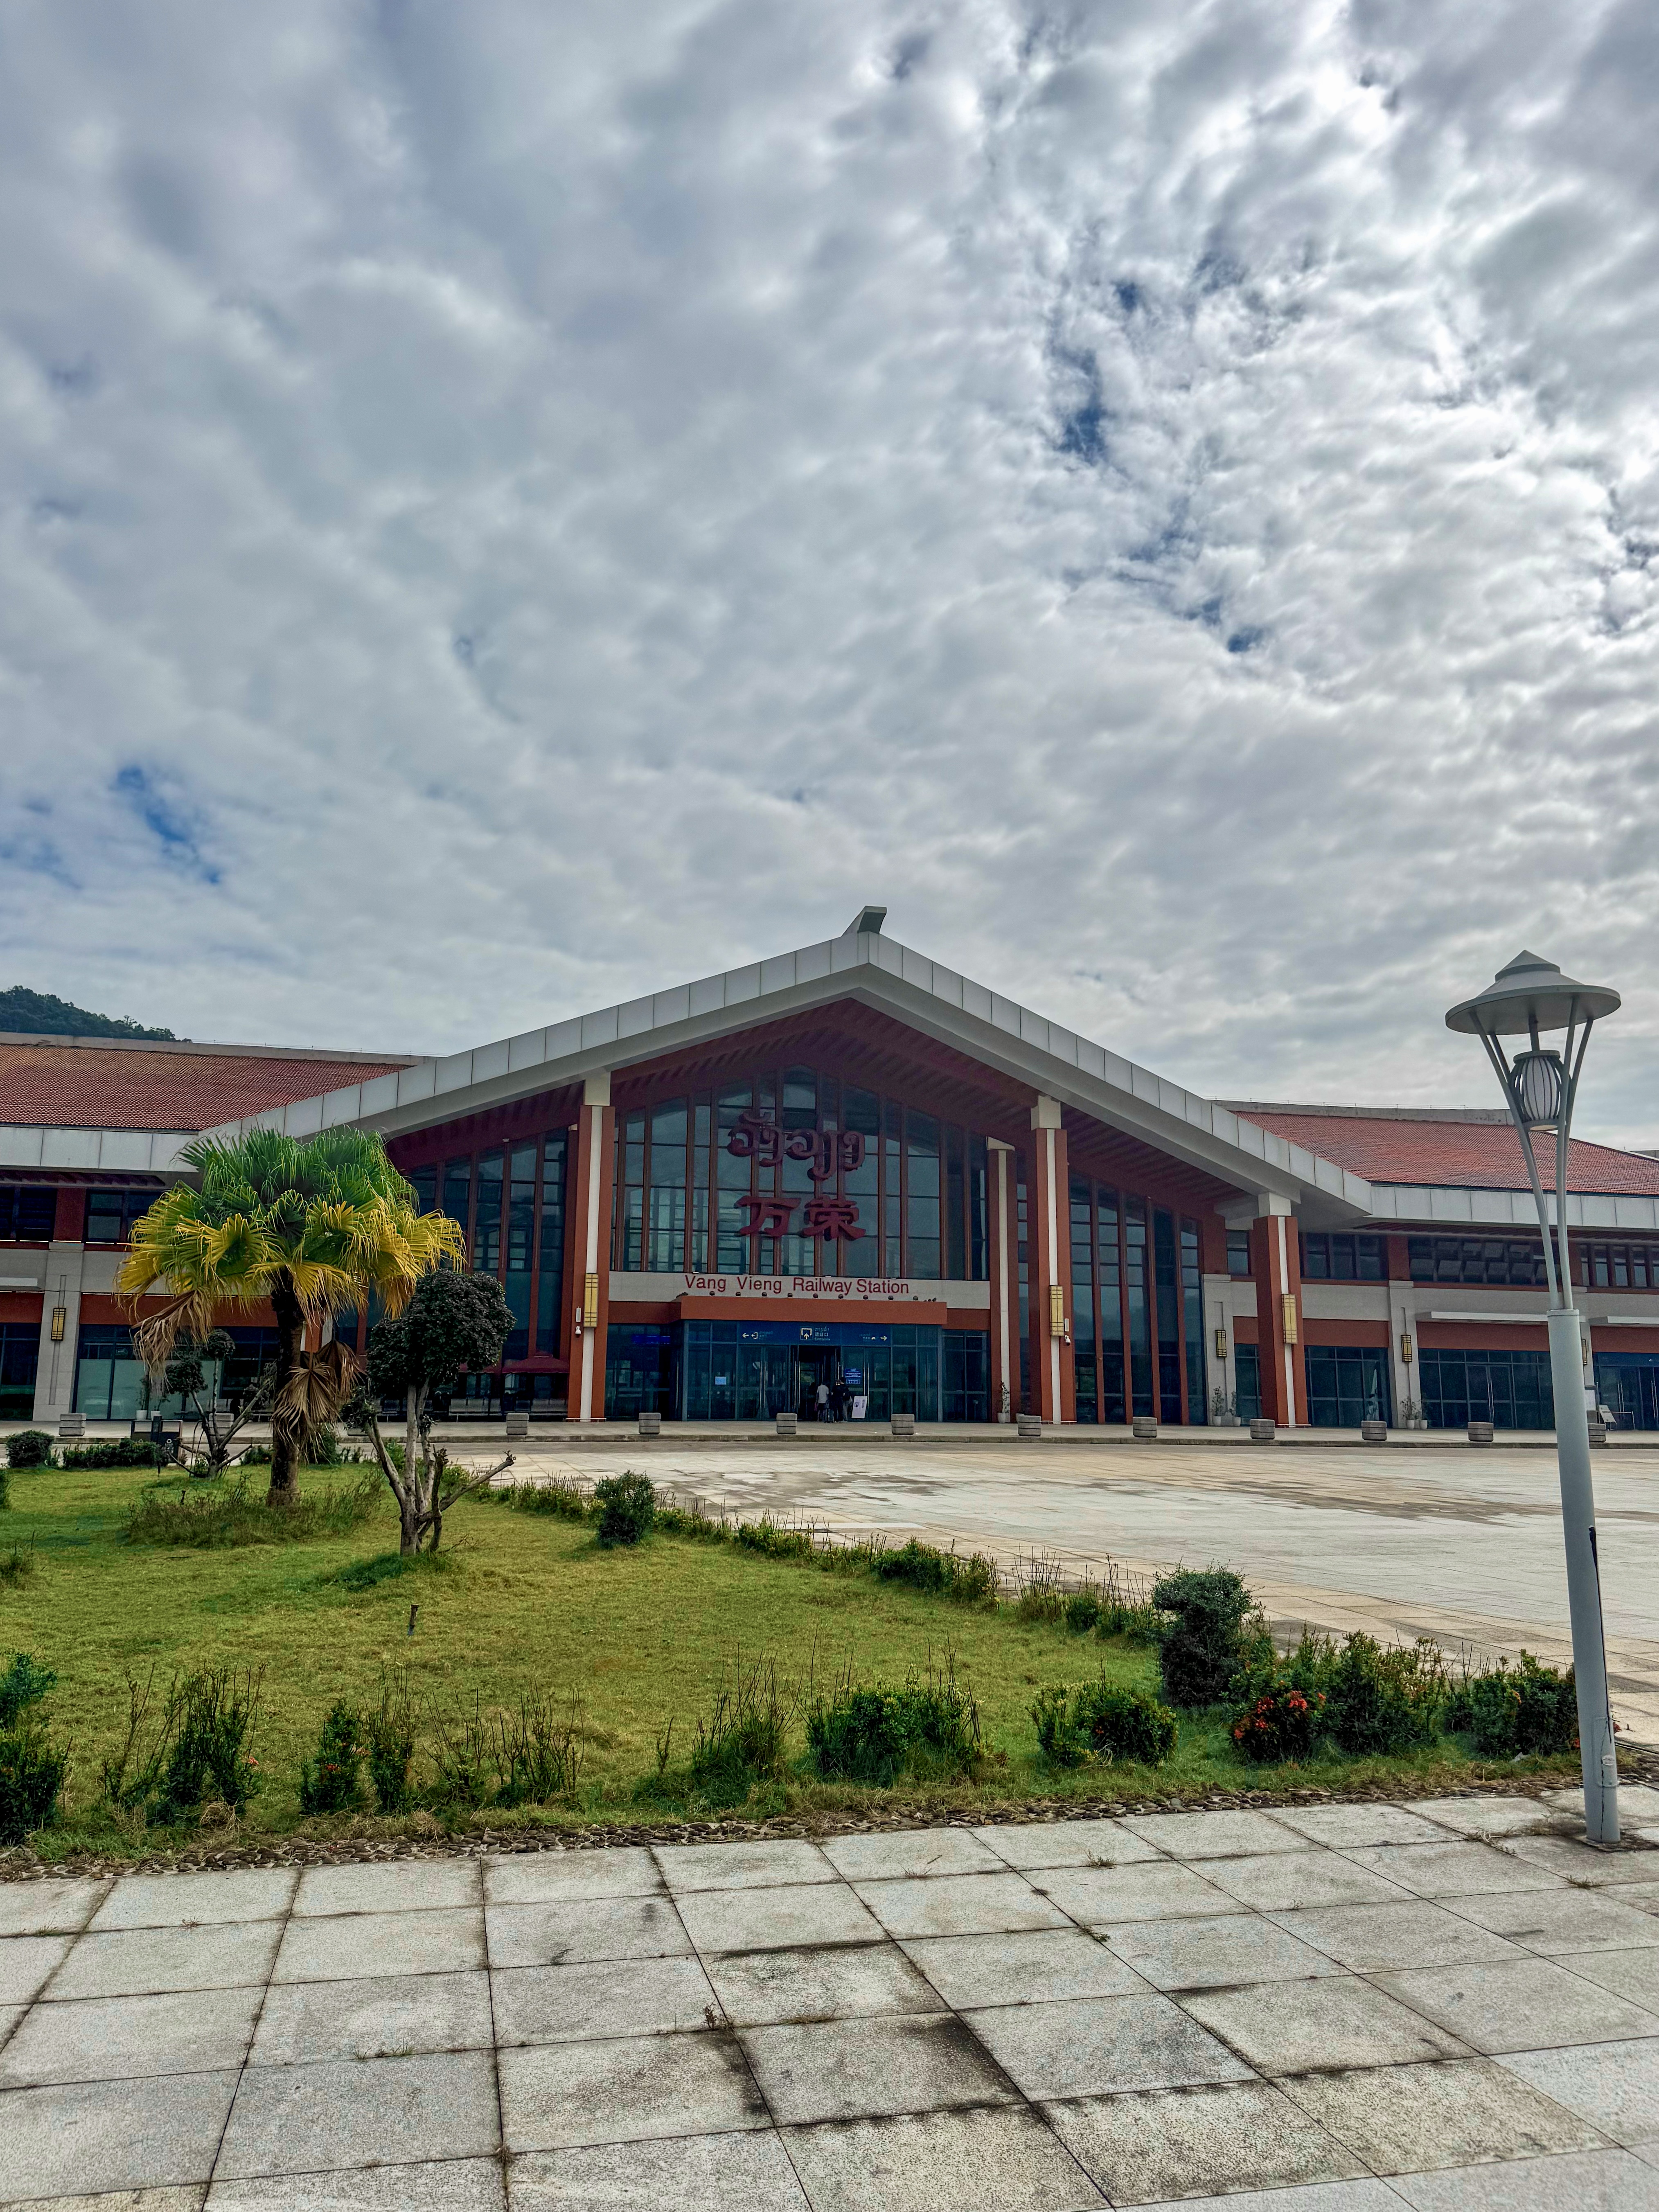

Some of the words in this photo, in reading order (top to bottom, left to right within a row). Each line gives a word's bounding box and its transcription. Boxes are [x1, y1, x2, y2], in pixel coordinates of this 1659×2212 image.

[727, 1111, 866, 1181] ວັງວຽງ
[734, 1195, 866, 1241] 万荣
[685, 1275, 726, 1292] Vang
[737, 1276, 782, 1294] Vieng
[793, 1277, 852, 1296] Railway
[856, 1279, 909, 1293] Station
